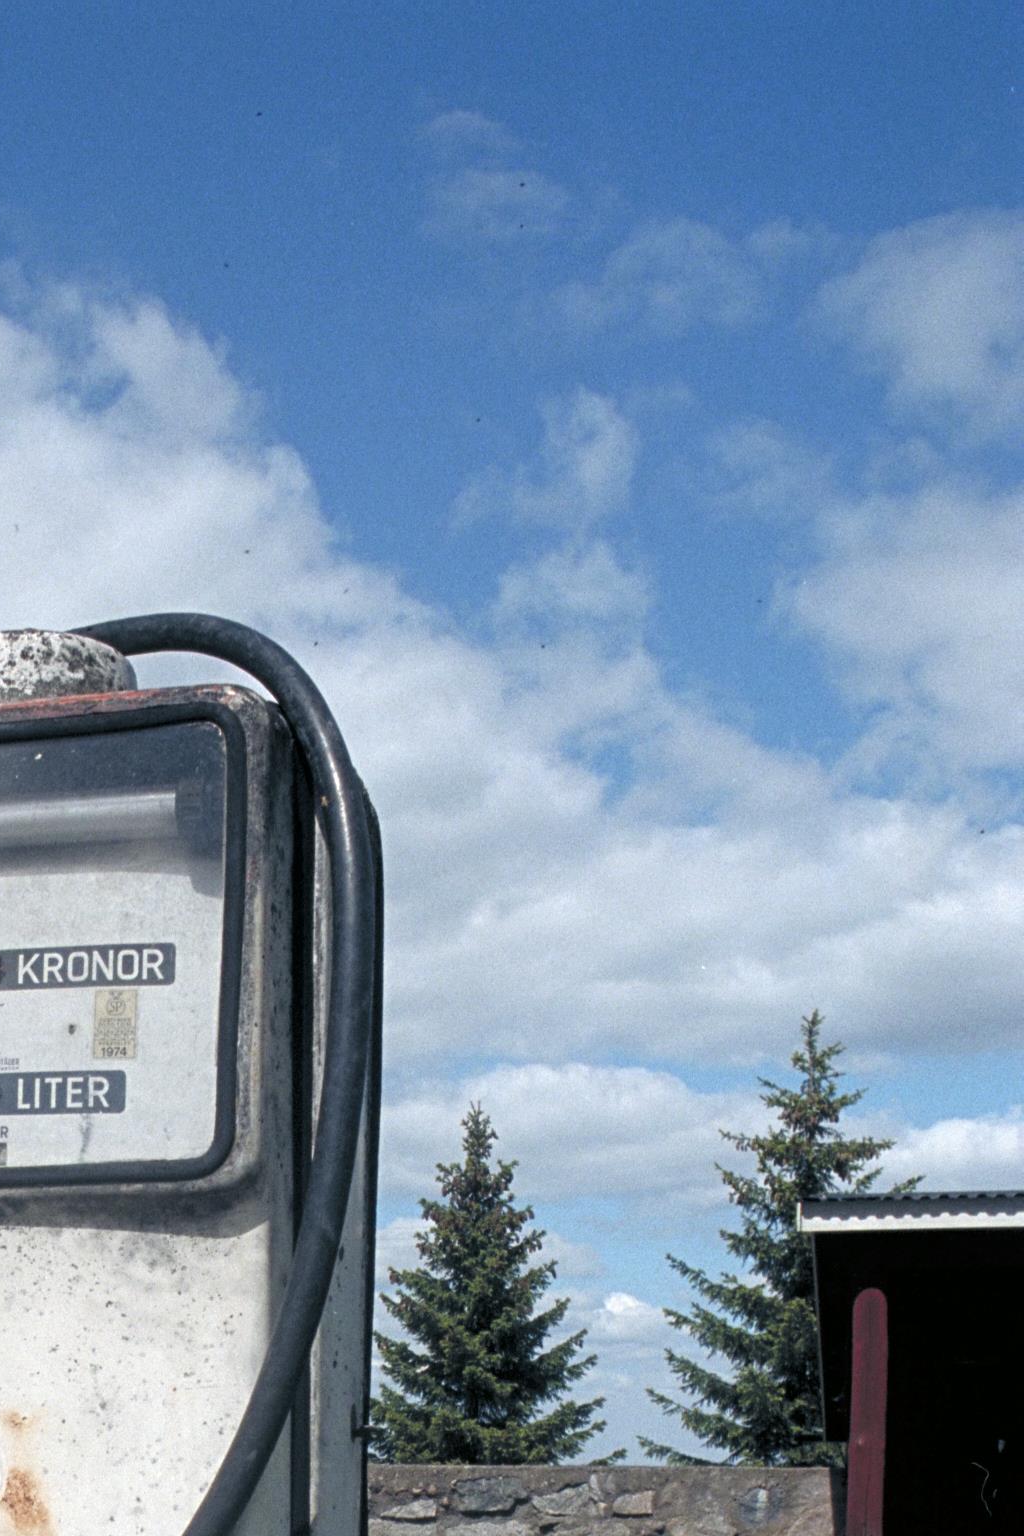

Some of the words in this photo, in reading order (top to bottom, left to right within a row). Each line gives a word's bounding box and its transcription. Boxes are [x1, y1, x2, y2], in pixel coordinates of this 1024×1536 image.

[16, 948, 165, 985] KRONOR
[101, 1046, 127, 1058] 1974
[16, 1077, 111, 1111] LITER
